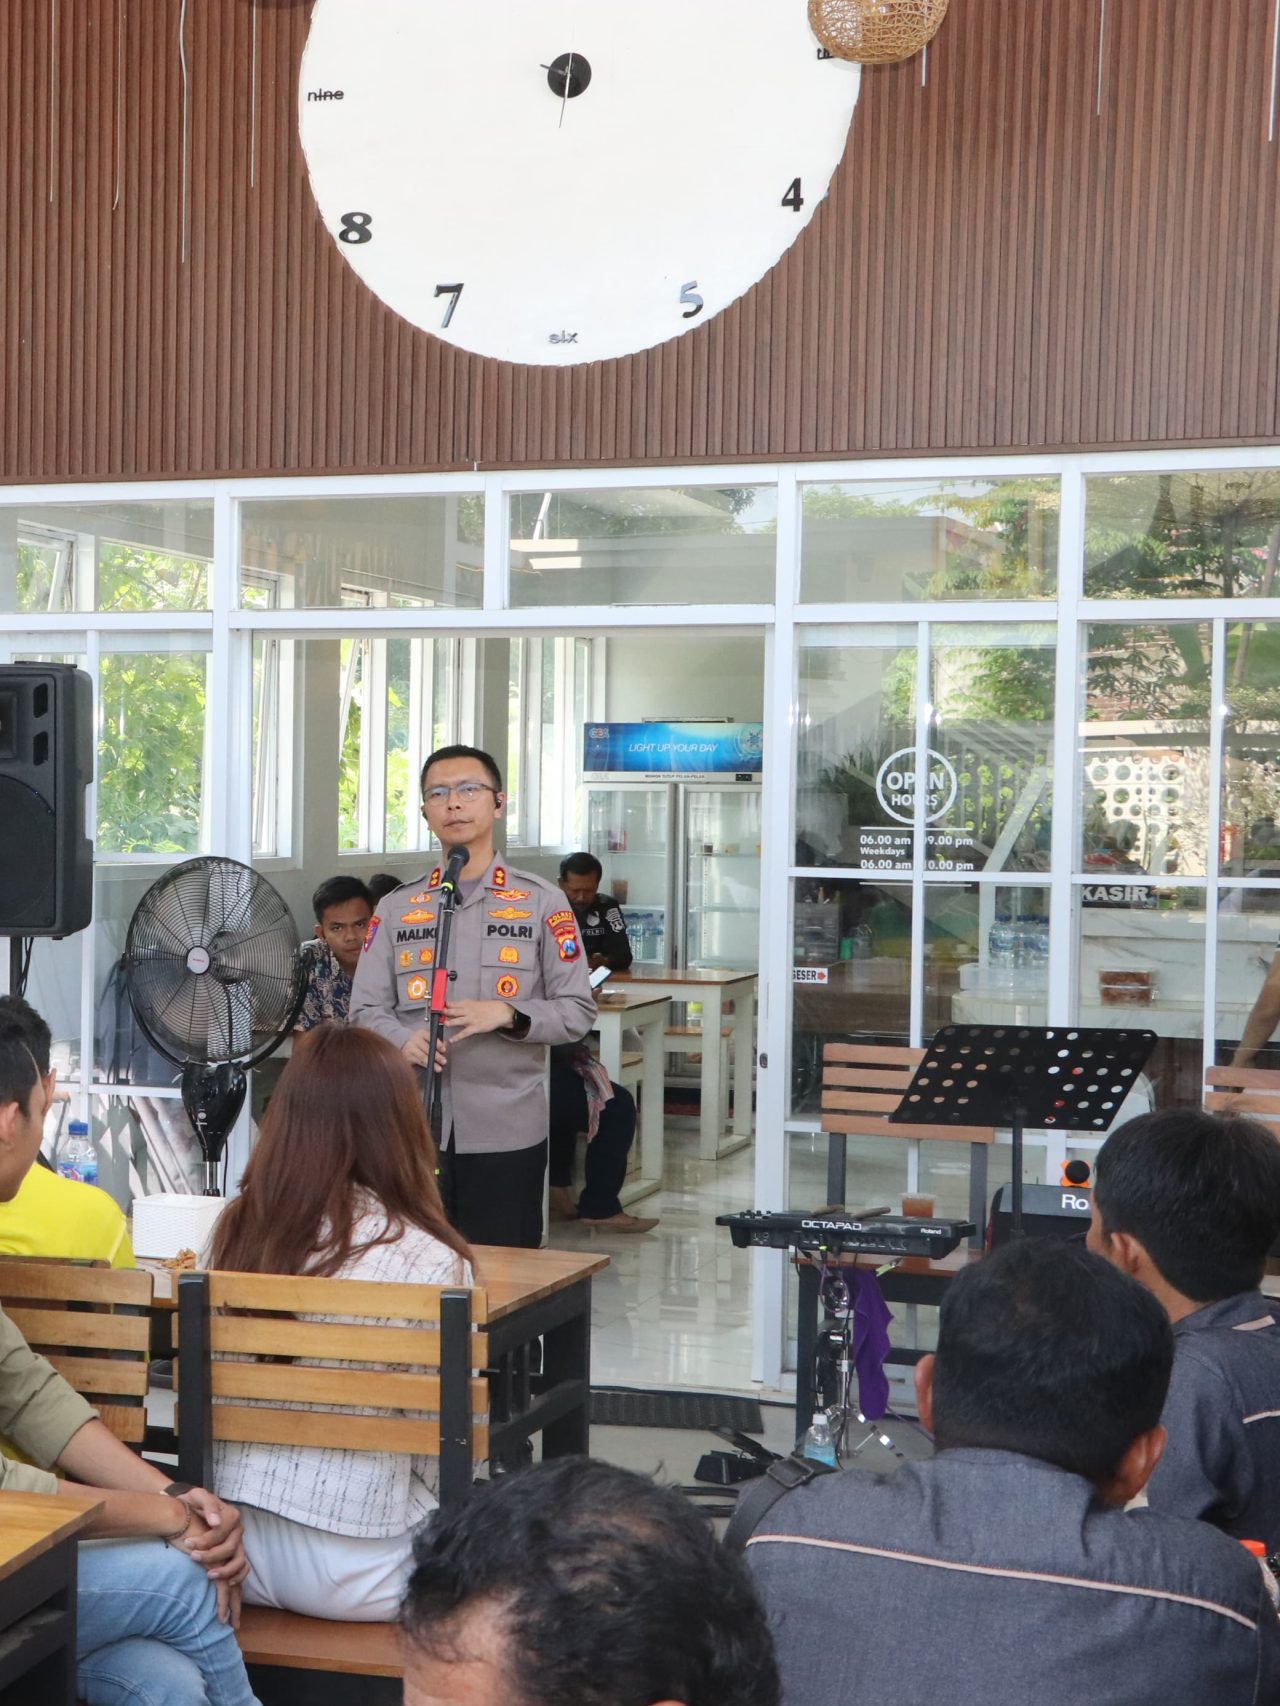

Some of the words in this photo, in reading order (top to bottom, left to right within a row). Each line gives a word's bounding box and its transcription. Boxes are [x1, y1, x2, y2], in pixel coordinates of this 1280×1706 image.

[781, 177, 804, 212] 4
[338, 211, 372, 244] 8
[433, 283, 464, 328] 7
[679, 281, 704, 319] 5
[548, 329, 578, 344] six
[629, 743, 655, 752] LIGHT
[657, 743, 670, 752] UP
[673, 743, 698, 752] YOUR
[699, 743, 718, 752] DAY
[886, 771, 944, 790] OPN
[860, 835, 892, 845] 06.00
[894, 837, 911, 845] am
[924, 835, 953, 845] 9.00
[955, 838, 973, 848] pm
[860, 847, 906, 857] Weekdays
[860, 860, 892, 870] 06.00
[895, 862, 912, 870] am
[925, 860, 953, 870] 0.00
[955, 862, 974, 871] pm
[1082, 886, 1149, 901] KASIR
[487, 925, 533, 939] POLRI
[801, 1220, 862, 1231] OCTAPAD
